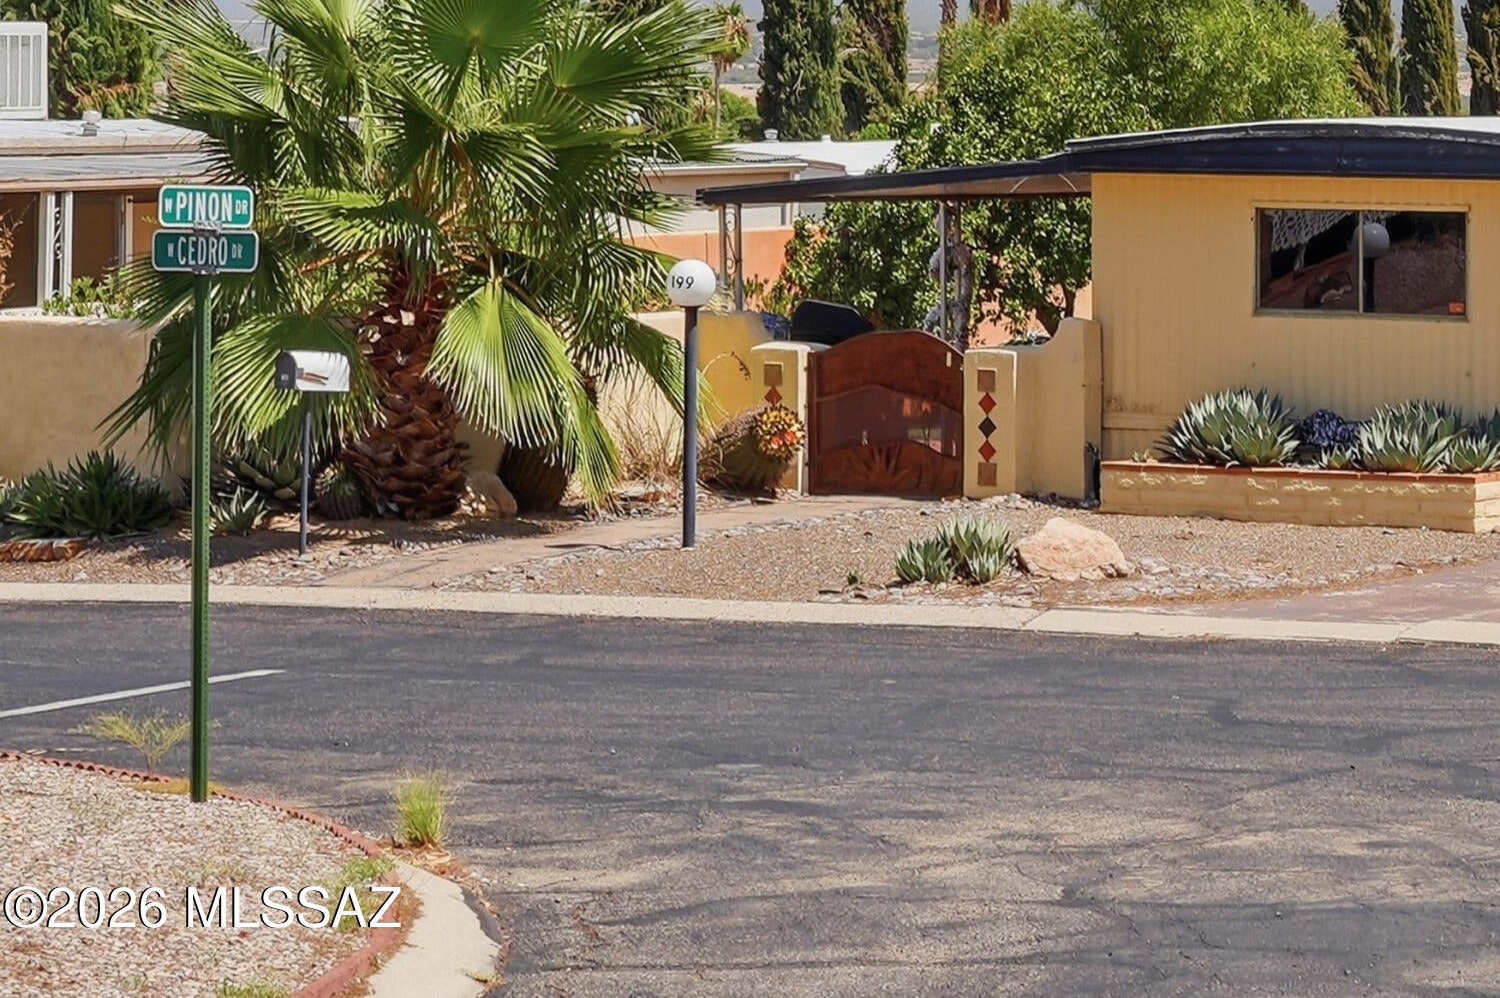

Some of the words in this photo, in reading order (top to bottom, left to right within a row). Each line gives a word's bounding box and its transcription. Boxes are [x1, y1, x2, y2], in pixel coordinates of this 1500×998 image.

[164, 197, 173, 213] W
[175, 191, 233, 222] PINON
[235, 199, 249, 215] DR
[167, 242, 174, 258] W
[177, 235, 228, 266] CEDRO
[231, 243, 243, 259] DR
[671, 275, 695, 290] 199
